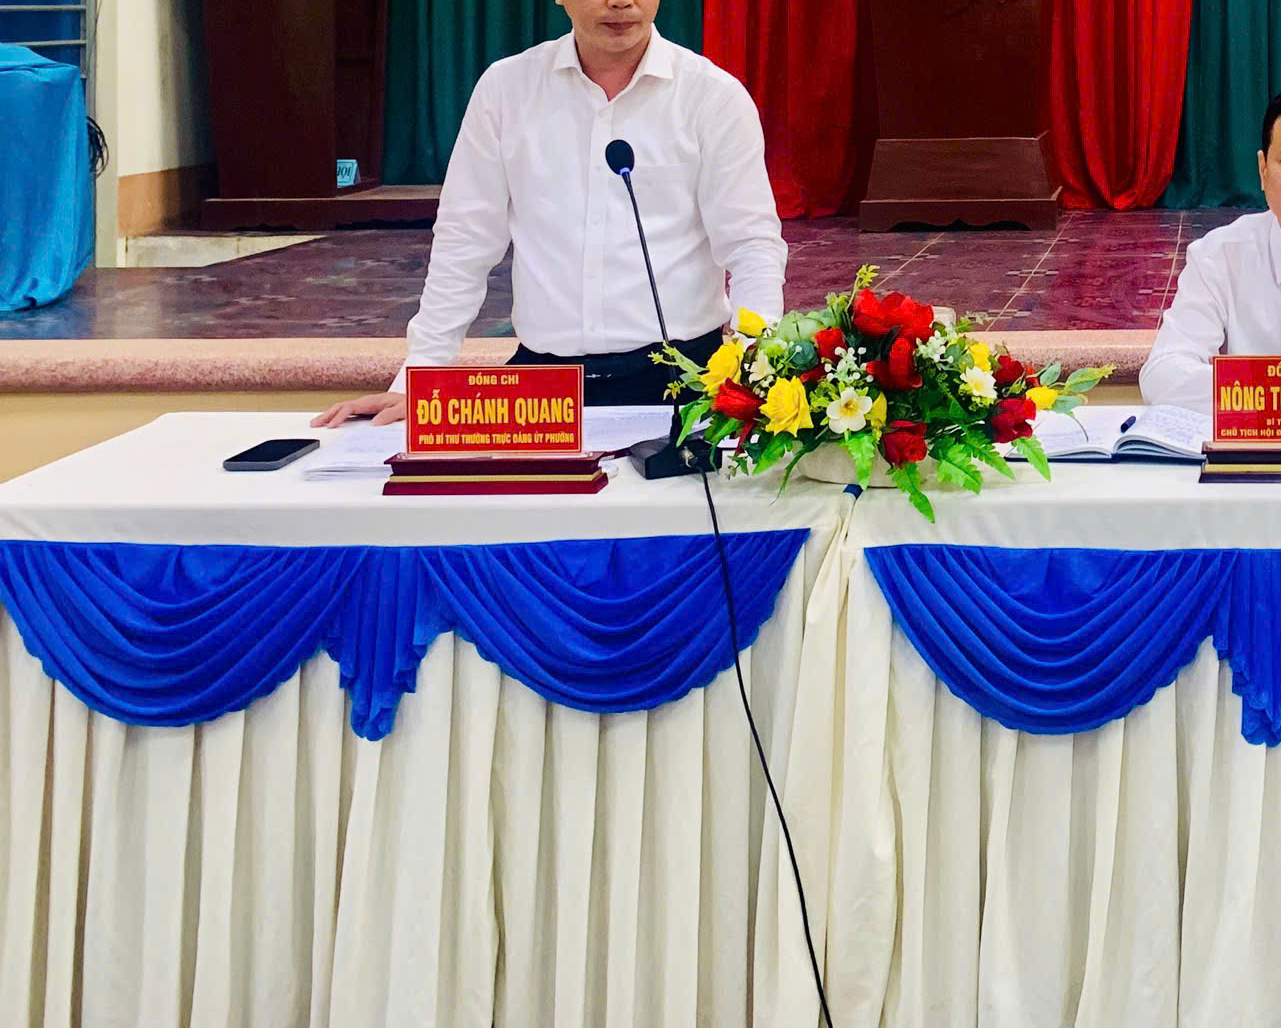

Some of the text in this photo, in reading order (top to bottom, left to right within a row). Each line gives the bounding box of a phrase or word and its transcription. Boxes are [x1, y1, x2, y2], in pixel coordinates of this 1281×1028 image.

[500, 372, 519, 384] CHÍ
[416, 389, 574, 426] ĐỖ CHÁNH QUANG
[1220, 380, 1264, 411] NÔNG
